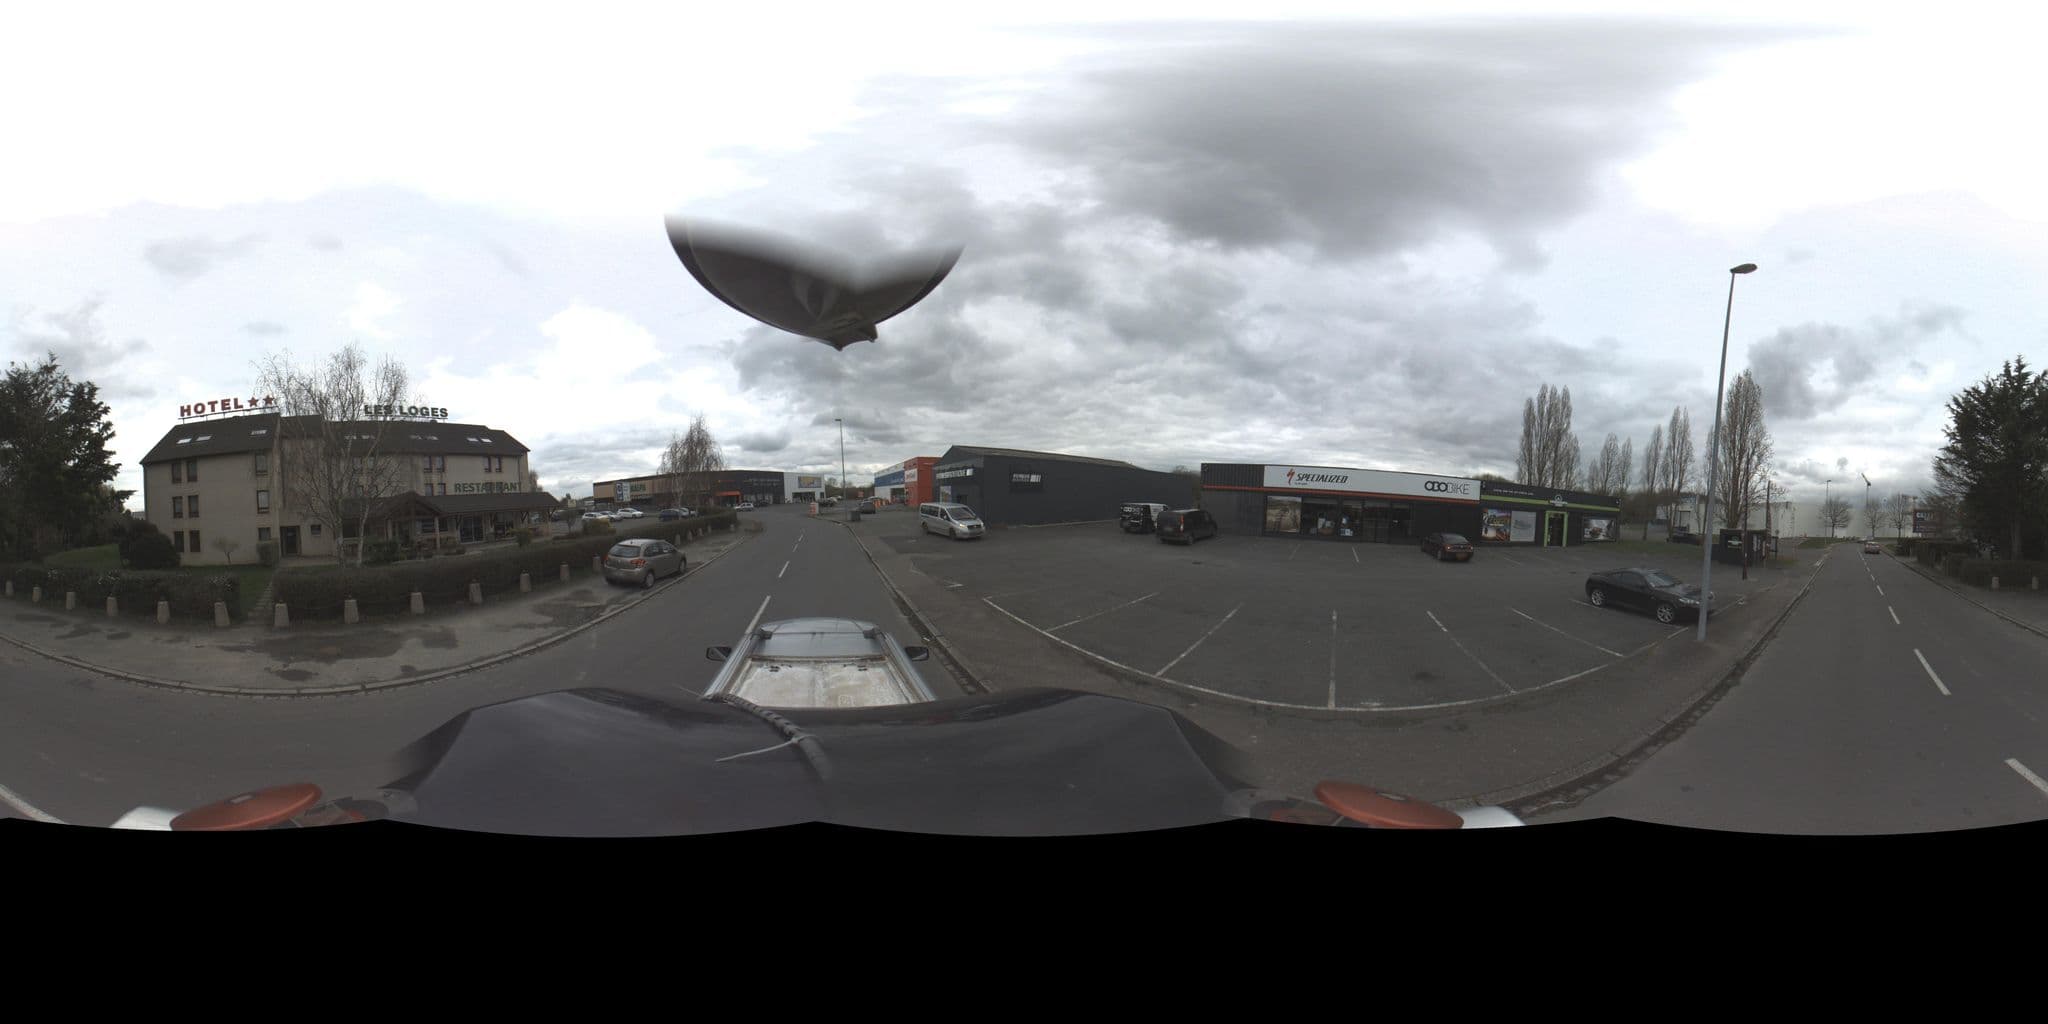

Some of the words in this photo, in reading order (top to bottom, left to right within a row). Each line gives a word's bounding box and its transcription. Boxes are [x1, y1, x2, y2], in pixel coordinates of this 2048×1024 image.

[180, 398, 243, 417] HOTEL
[364, 404, 393, 415] LES
[400, 404, 448, 417] LOGES
[1296, 473, 1349, 484] SPECIALIZED
